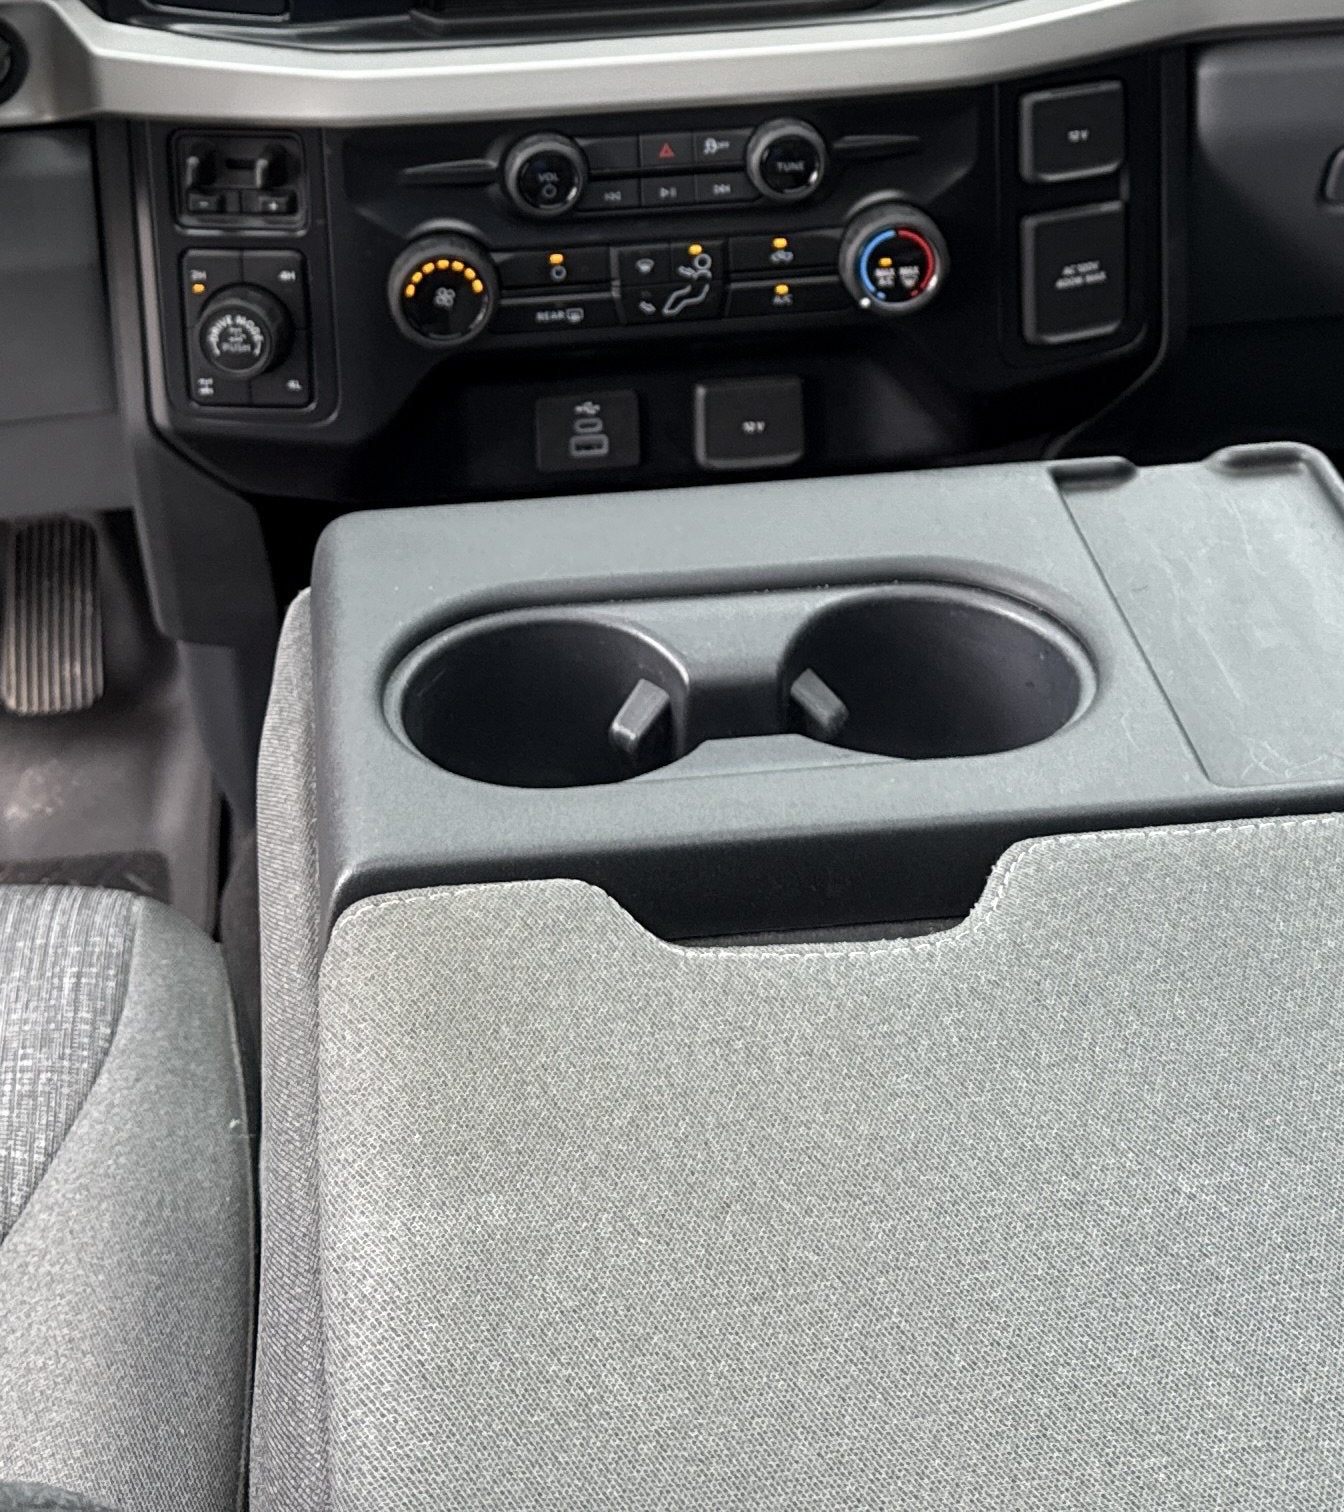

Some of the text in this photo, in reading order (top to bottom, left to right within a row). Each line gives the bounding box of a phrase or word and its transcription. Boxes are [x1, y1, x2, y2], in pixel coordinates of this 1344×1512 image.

[776, 161, 805, 173] TUNE
[537, 172, 559, 184] VOL
[535, 309, 566, 323] REAR
